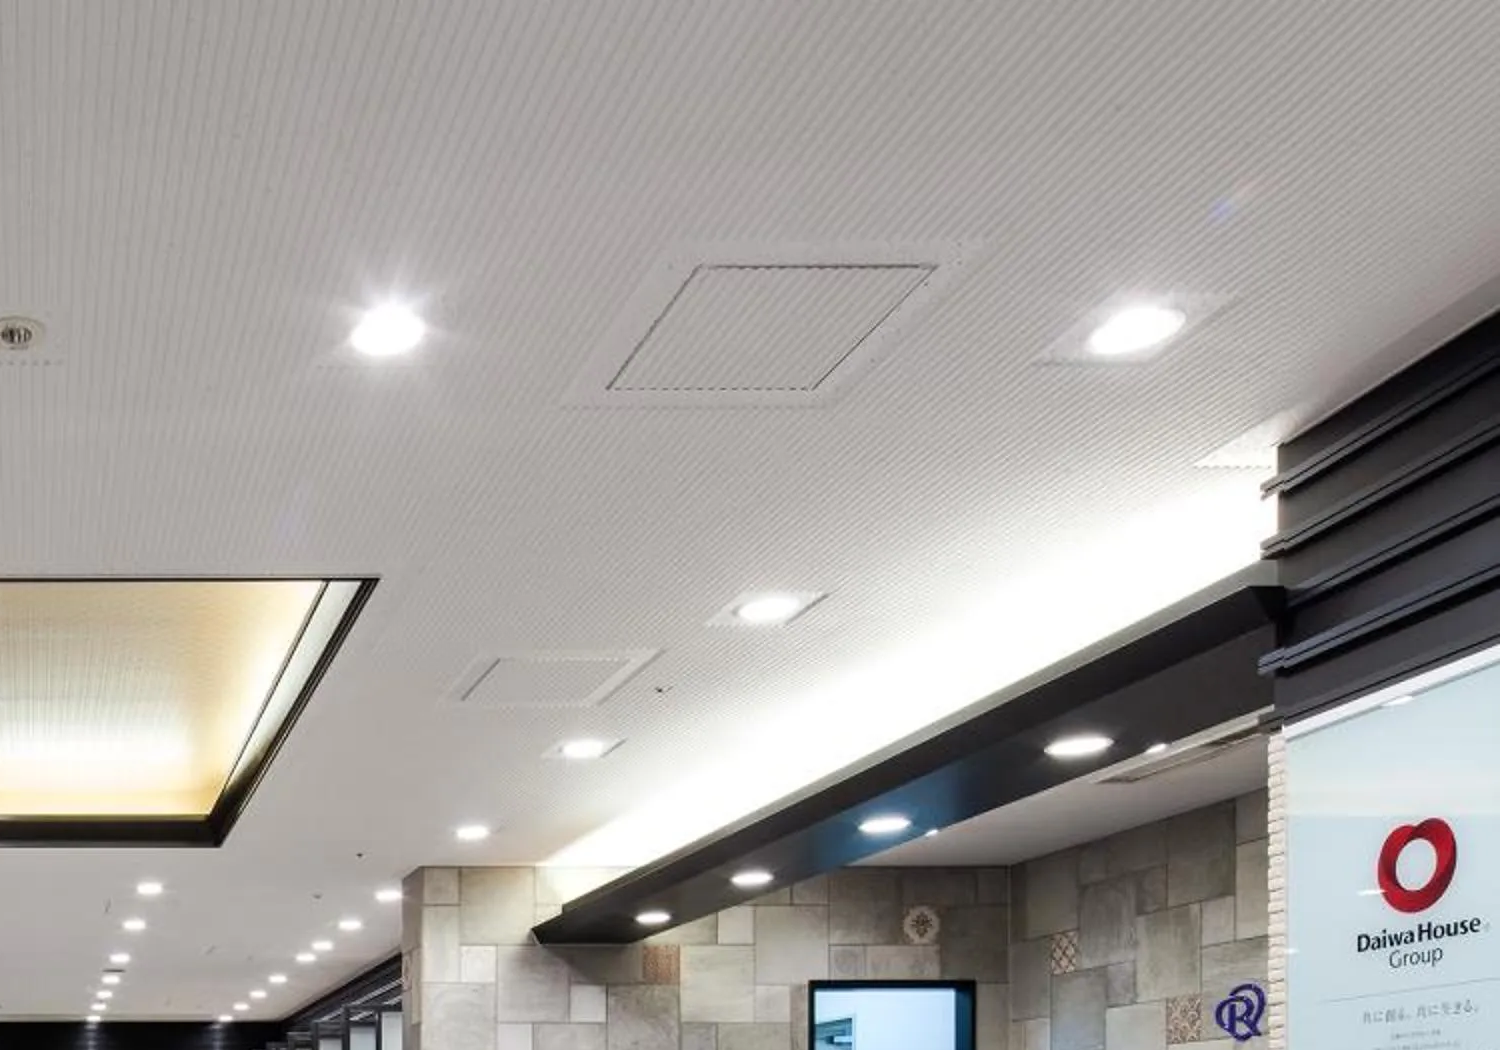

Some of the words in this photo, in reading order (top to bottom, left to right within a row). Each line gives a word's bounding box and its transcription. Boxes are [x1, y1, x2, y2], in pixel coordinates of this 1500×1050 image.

[1357, 930, 1415, 952] Daiwa
[1417, 917, 1481, 942] House
[1389, 947, 1443, 969] Group
